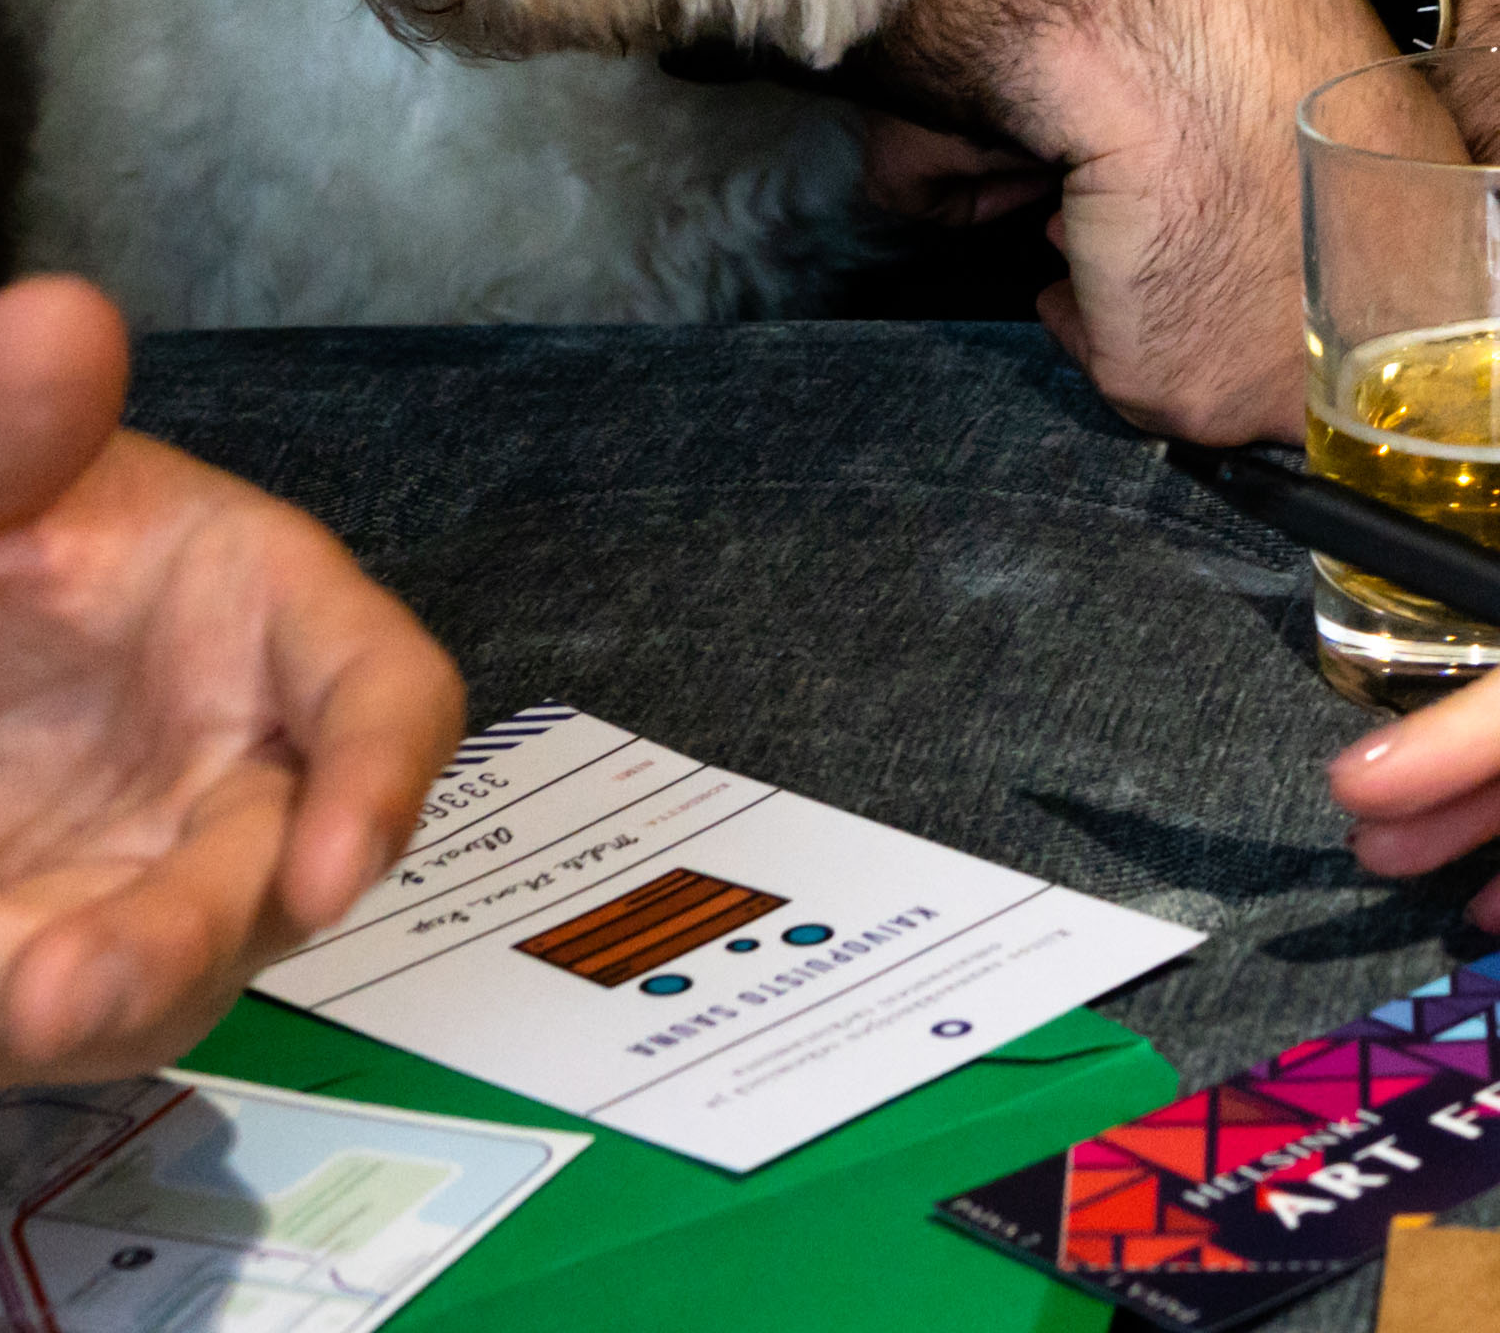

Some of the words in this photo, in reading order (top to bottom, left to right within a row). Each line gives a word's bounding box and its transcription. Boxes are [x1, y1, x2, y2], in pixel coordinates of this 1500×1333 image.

[737, 906, 939, 1005] KAIVOPUISTO
[626, 1004, 738, 1056] SAUNA
[1182, 1109, 1382, 1208] HELSINKI
[1267, 1134, 1421, 1230] ART
